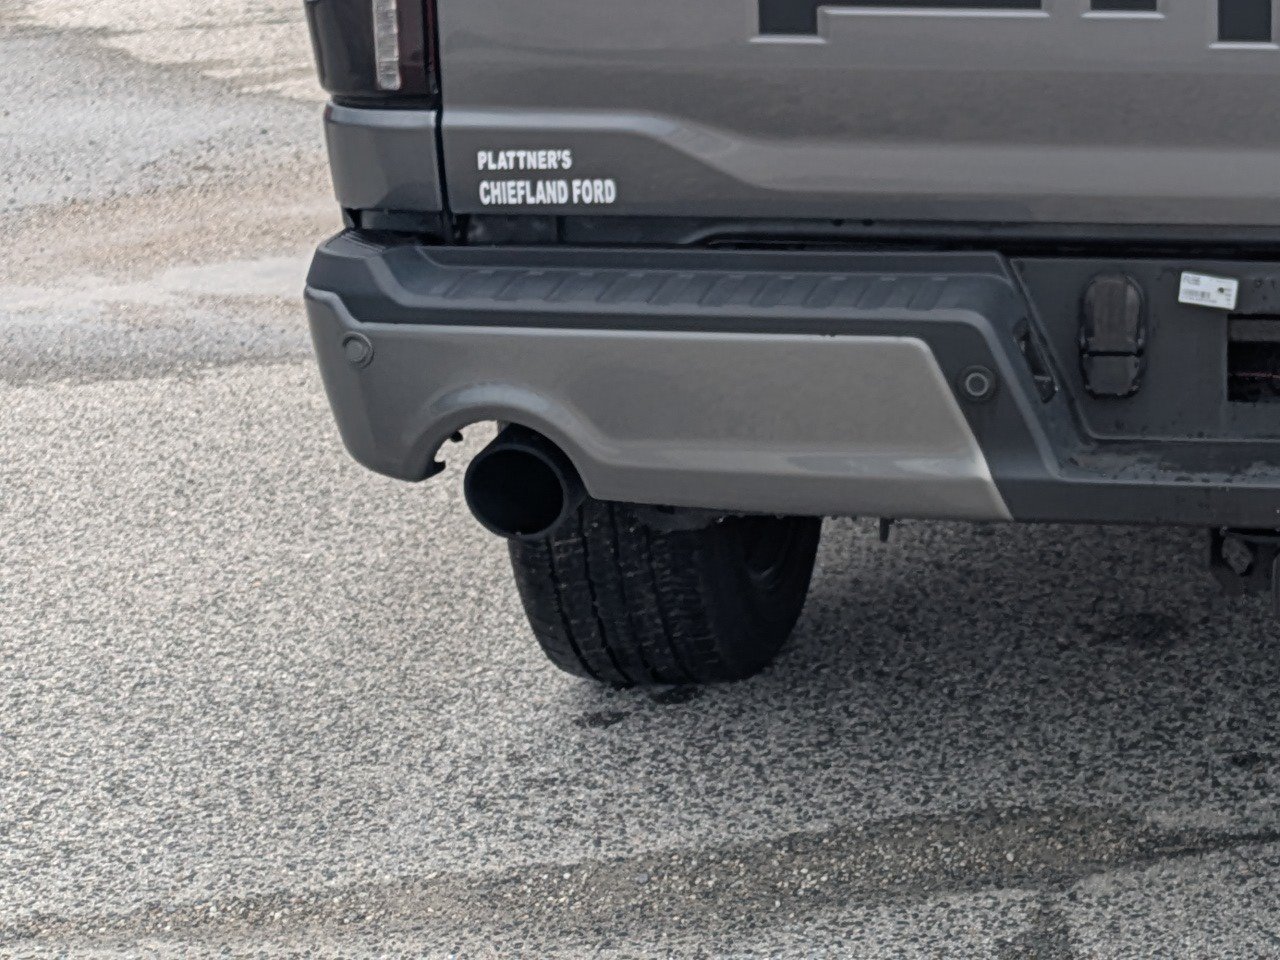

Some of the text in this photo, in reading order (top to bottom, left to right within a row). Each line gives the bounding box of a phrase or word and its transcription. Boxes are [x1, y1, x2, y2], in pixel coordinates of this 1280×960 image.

[477, 150, 572, 170] PLATTNER'S
[479, 179, 616, 205] CHIEFLAND FORD
